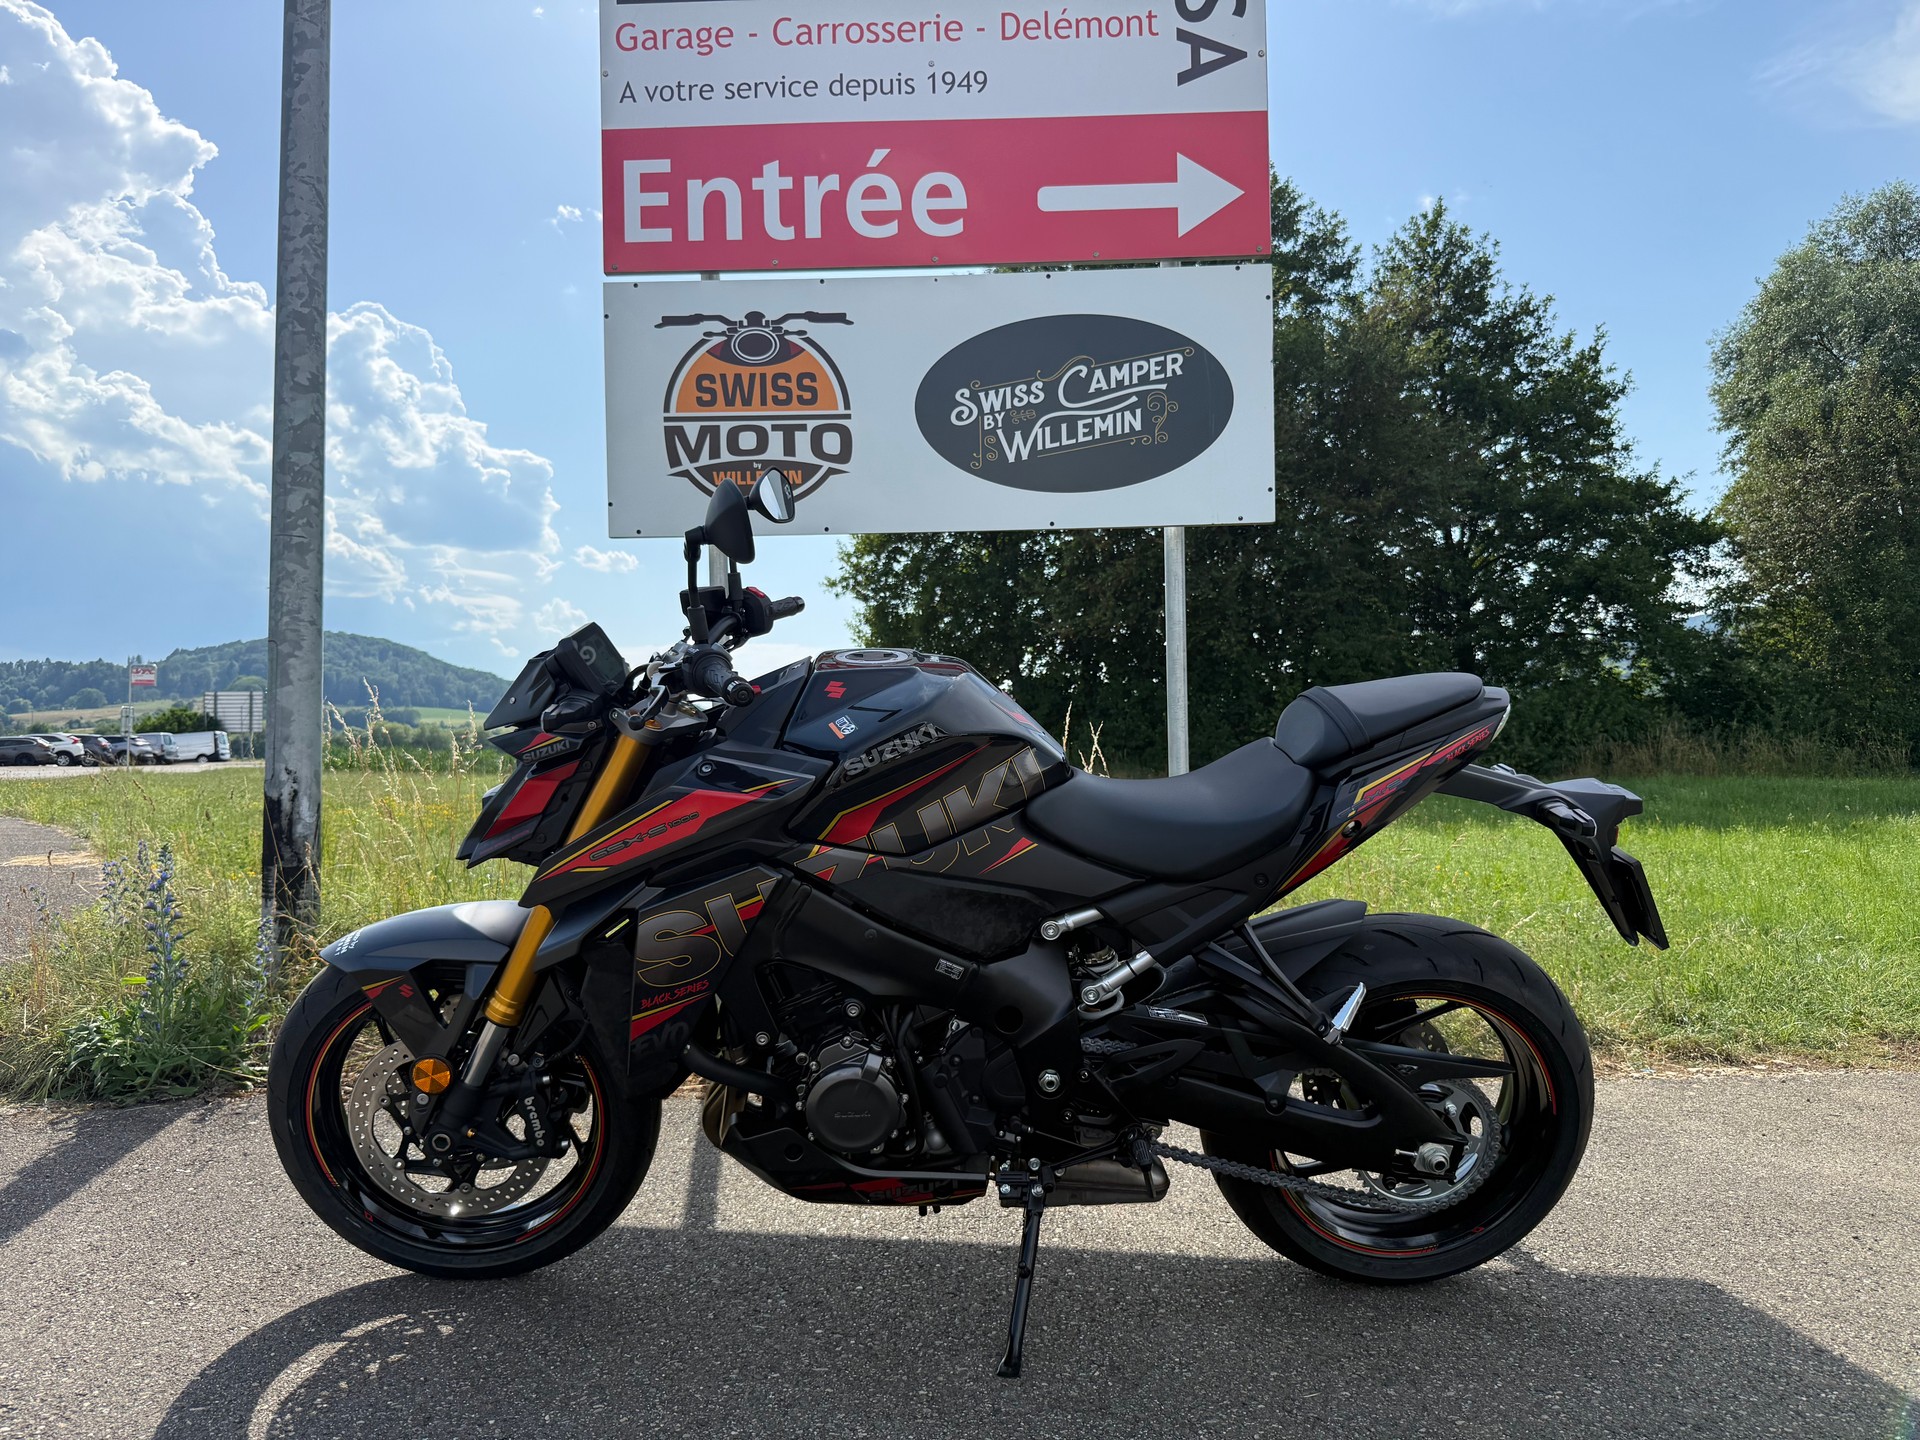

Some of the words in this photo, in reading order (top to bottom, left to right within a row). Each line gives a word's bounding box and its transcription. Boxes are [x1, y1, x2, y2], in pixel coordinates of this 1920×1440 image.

[615, 22, 734, 56] Garage
[772, 13, 964, 47] Carrosserie
[1000, 8, 1159, 42] Delémont
[619, 81, 637, 104] A
[644, 77, 715, 103] votre
[724, 75, 818, 100] service
[828, 72, 916, 102] depuis
[927, 70, 988, 95] 1949
[623, 148, 968, 243] Entrée
[695, 371, 819, 408] SWISS
[983, 411, 1006, 431] BY
[996, 396, 1142, 464] WILLEMIN
[663, 422, 853, 469] MOTO
[752, 461, 762, 470] by
[522, 739, 571, 765] SUZUKI
[843, 721, 949, 778] SUZUKI
[640, 991, 673, 1010] BLACK
[672, 979, 711, 1000] SERIES
[524, 1096, 546, 1147] brembo
